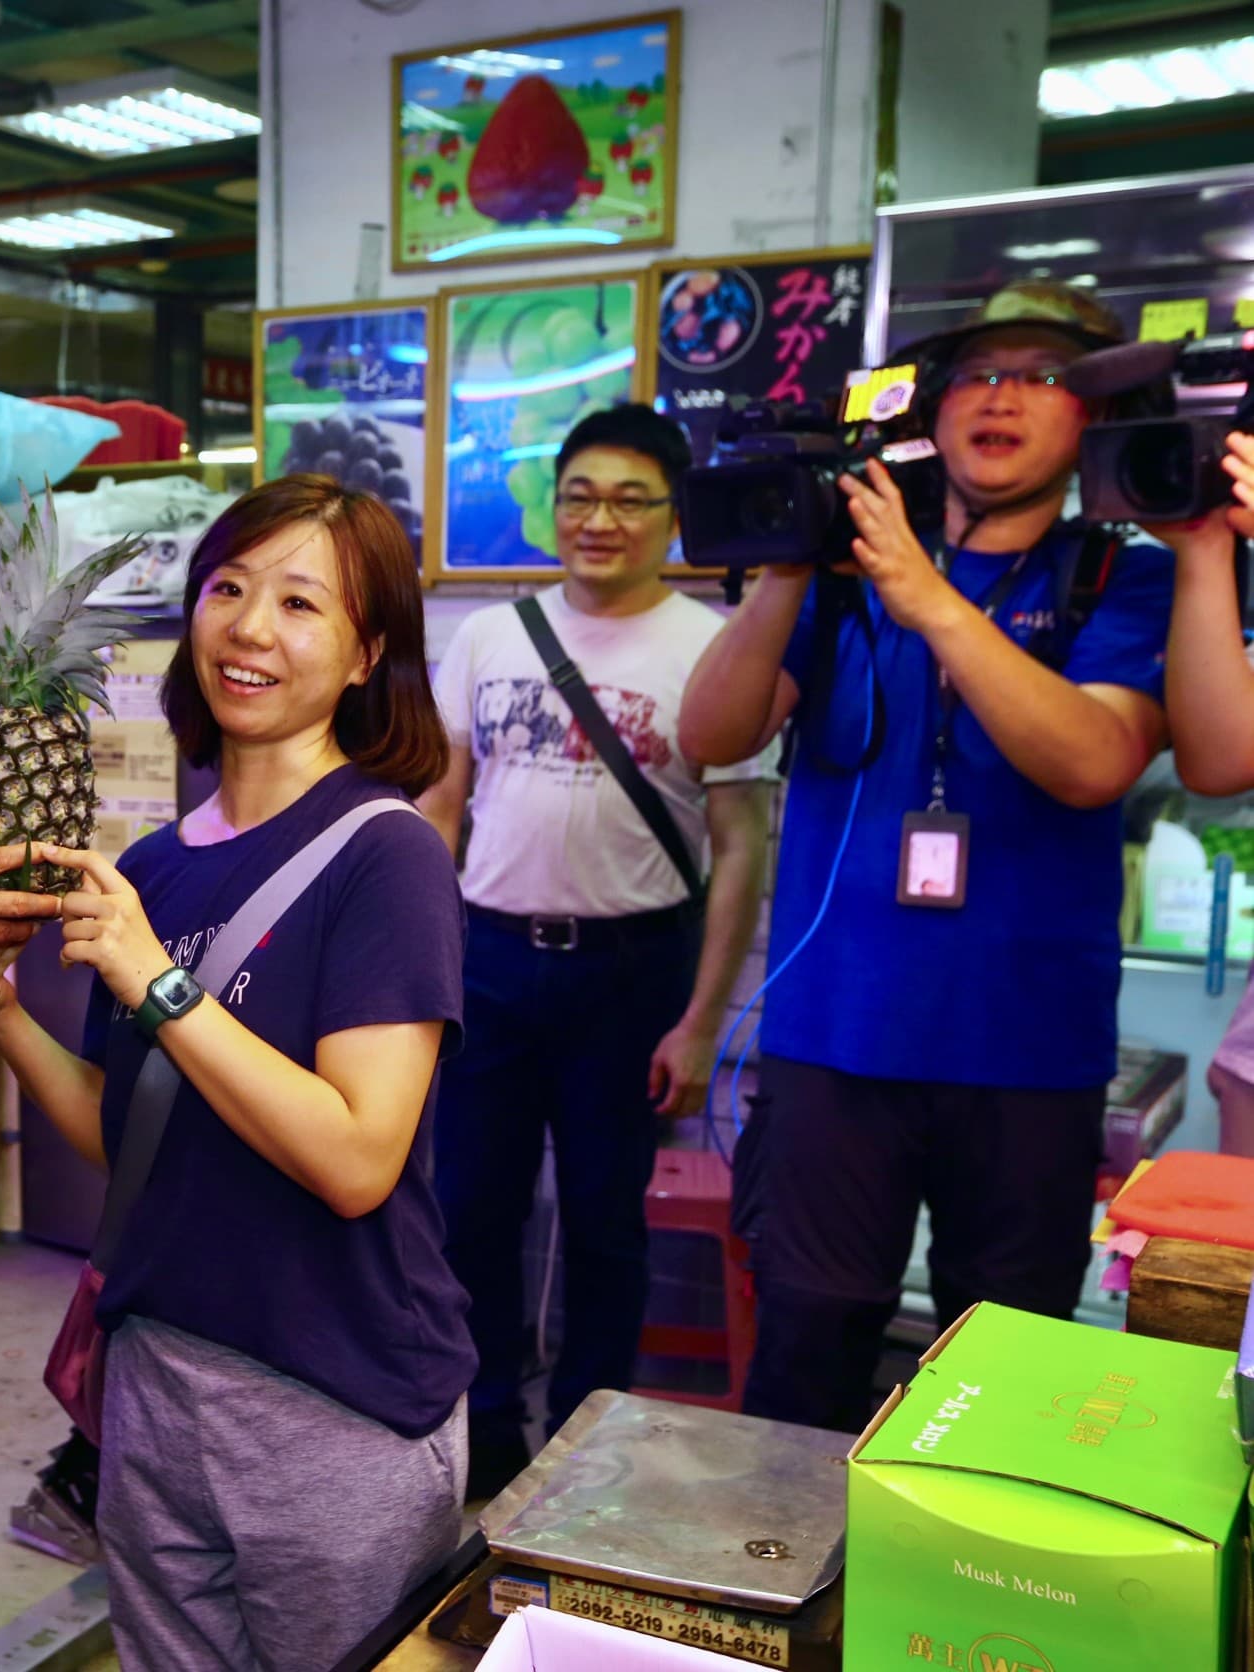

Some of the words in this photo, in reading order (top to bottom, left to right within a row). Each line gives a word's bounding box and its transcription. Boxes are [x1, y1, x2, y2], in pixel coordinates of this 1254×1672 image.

[767, 267, 833, 405] みかん
[953, 1558, 1006, 1588] Musk
[1013, 1574, 1077, 1606] Melon
[569, 1597, 663, 1633] 2992-5219
[678, 1623, 781, 1662] 2994-6478
